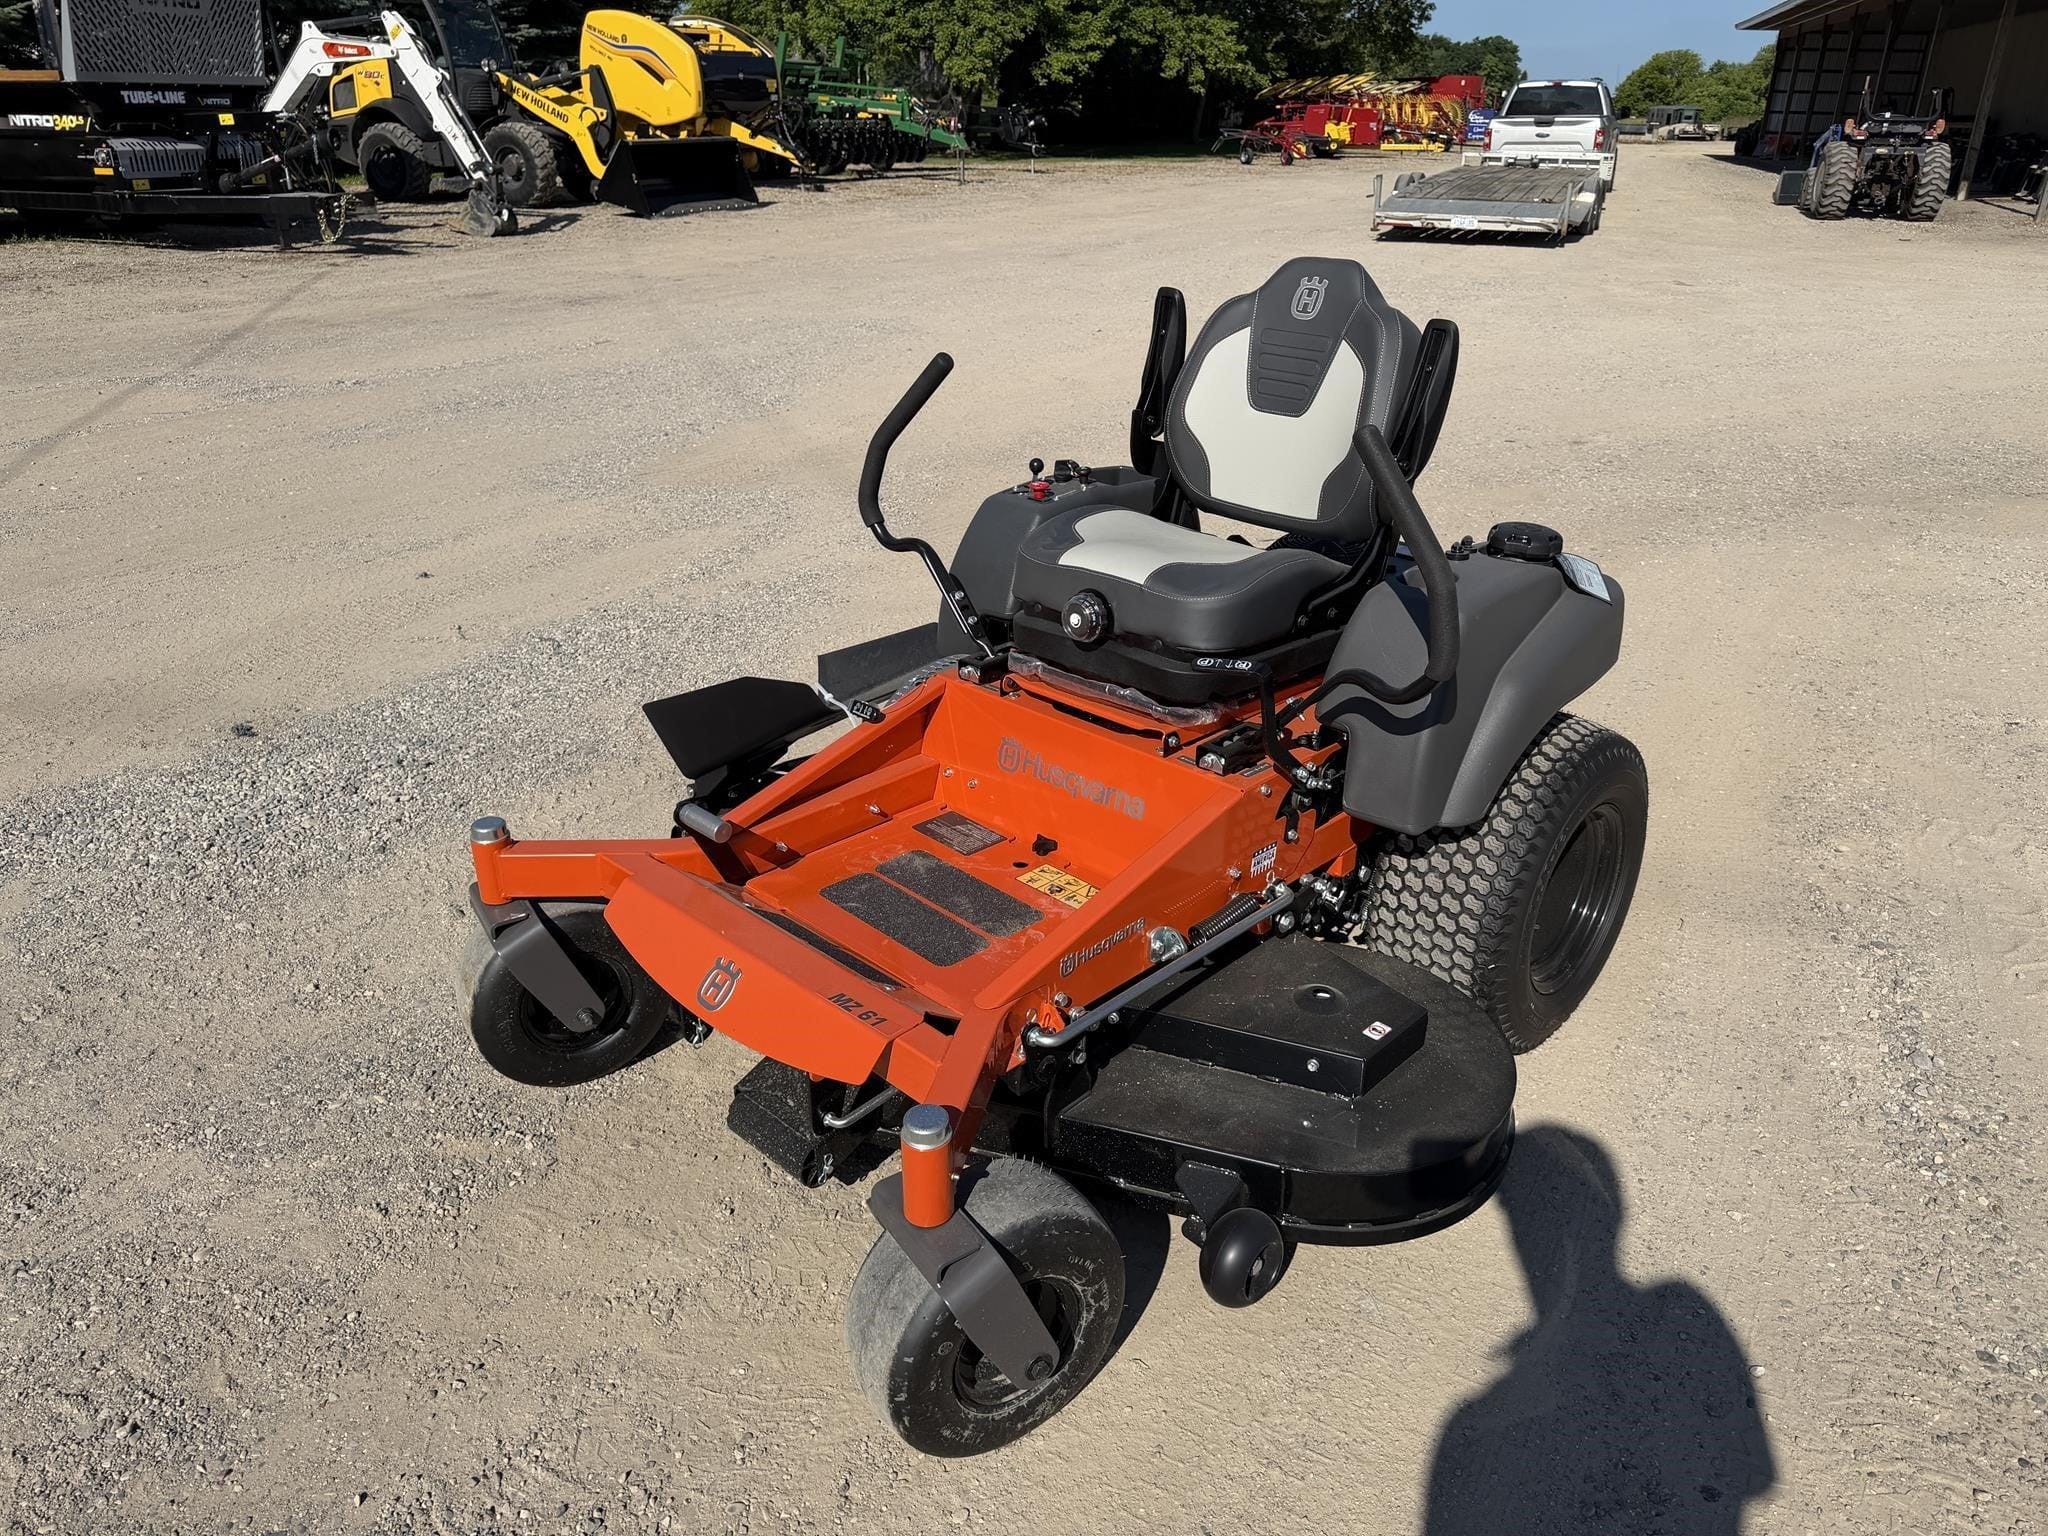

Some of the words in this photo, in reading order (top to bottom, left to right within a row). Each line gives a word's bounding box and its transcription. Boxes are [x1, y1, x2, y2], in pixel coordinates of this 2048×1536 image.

[8, 114, 54, 128] NITRO
[530, 96, 569, 123] HOLLAND
[1022, 750, 1145, 821] Husqvarna
[1075, 917, 1145, 967] Husqvarna
[828, 993, 863, 1012] MZ
[857, 1010, 887, 1027] 61
